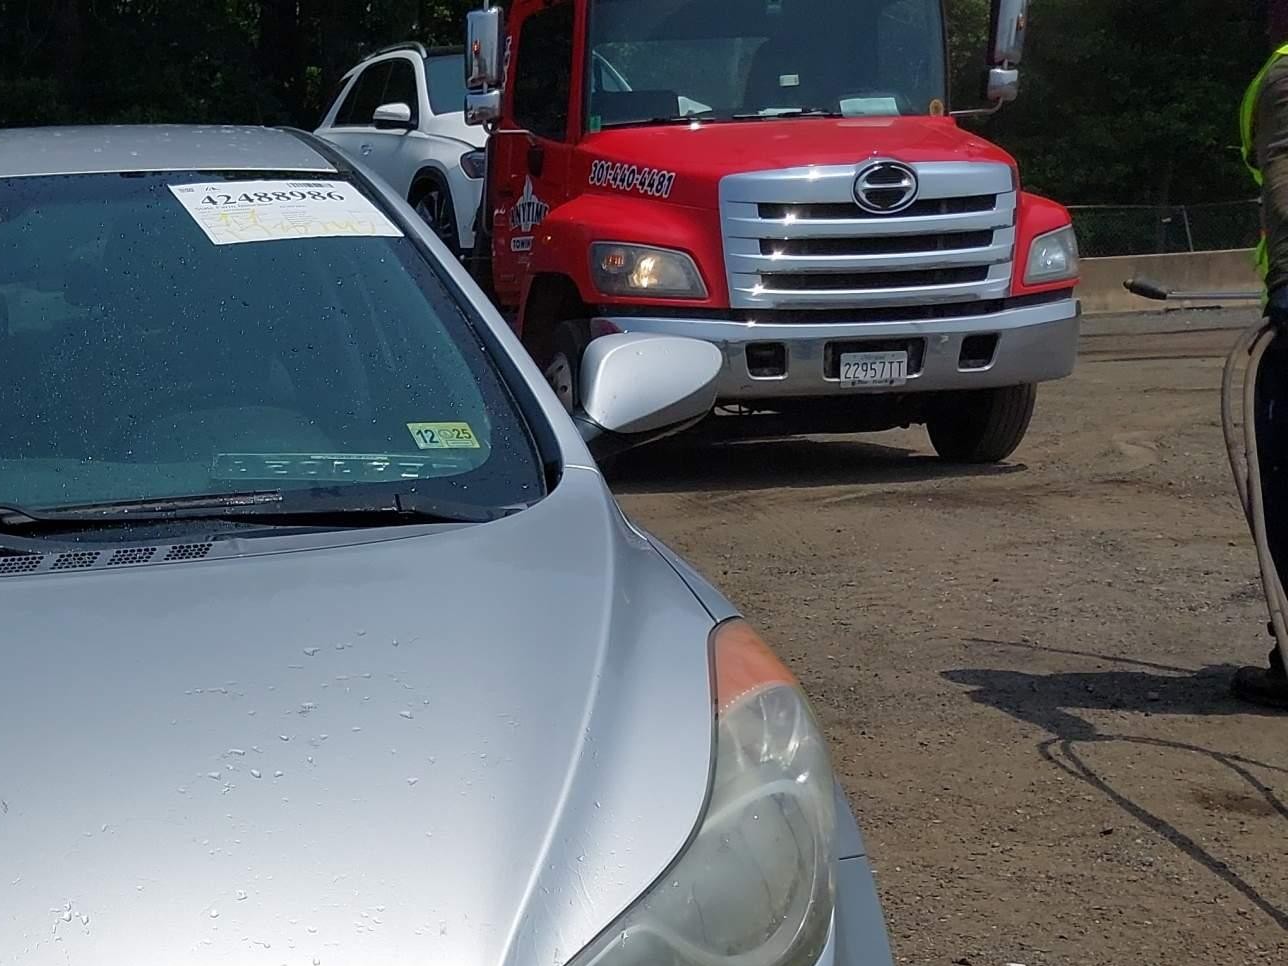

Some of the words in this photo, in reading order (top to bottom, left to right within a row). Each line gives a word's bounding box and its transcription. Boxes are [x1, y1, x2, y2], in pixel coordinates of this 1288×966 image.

[589, 160, 676, 198] 301-440-4481
[201, 190, 345, 206] 42488986
[510, 201, 550, 225] ANYTIM
[844, 360, 904, 380] 22957TT
[416, 429, 440, 444] 12
[452, 428, 472, 440] 25
